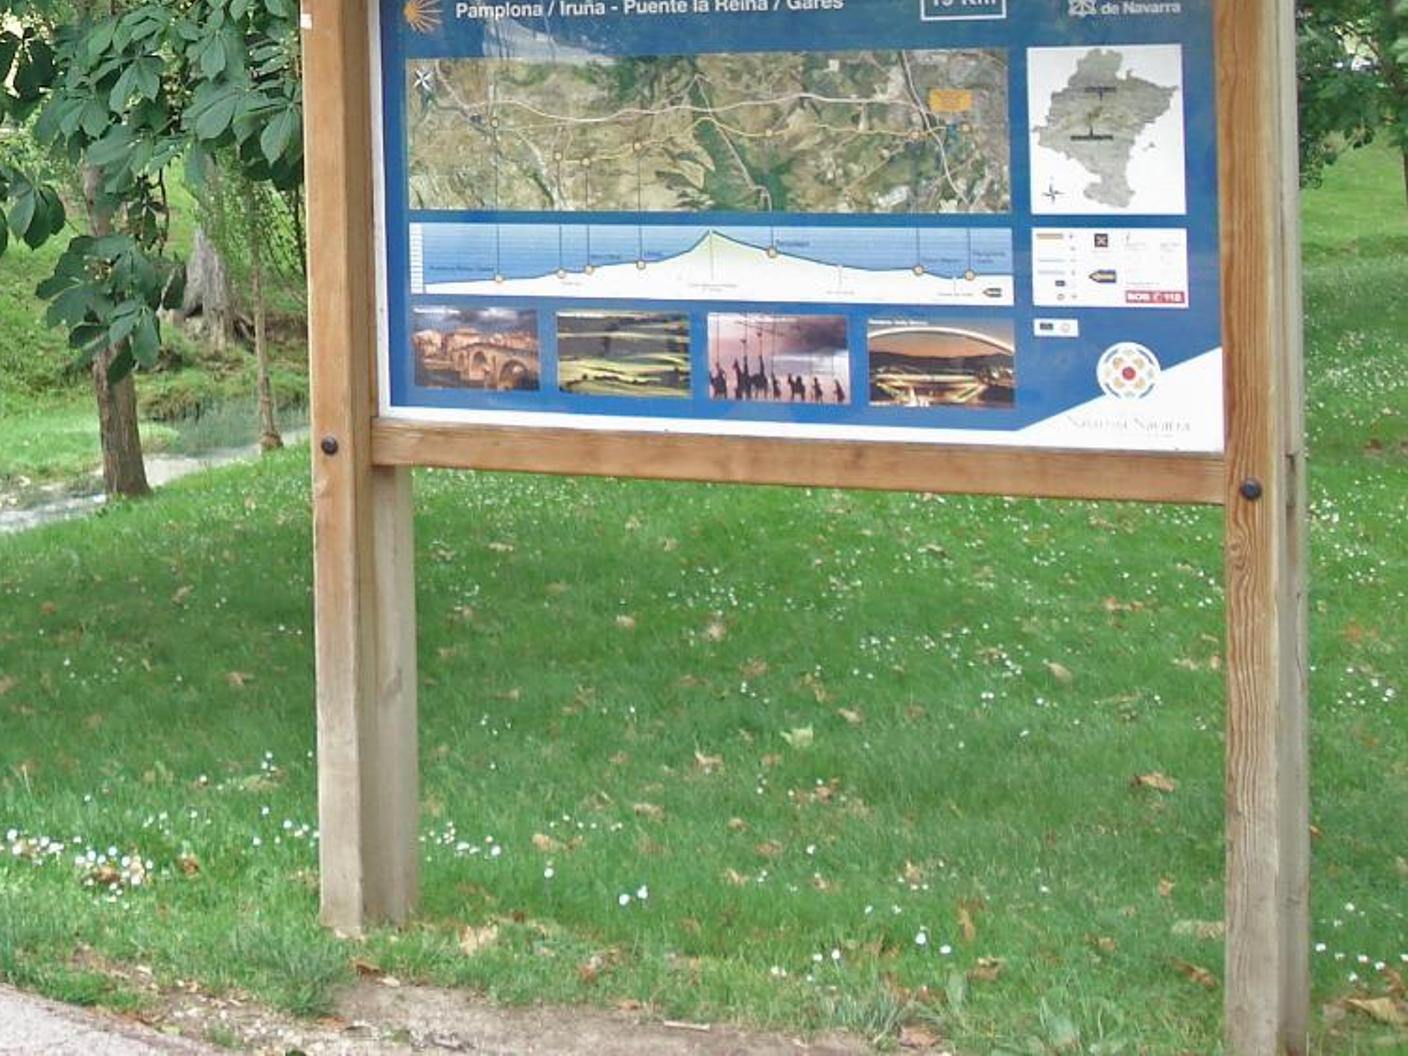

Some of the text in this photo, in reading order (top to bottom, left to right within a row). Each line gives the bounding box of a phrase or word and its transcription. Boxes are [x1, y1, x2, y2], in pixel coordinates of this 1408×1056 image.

[455, 1, 543, 20] Pamplona
[548, 0, 556, 17] /
[1101, 1, 1182, 15] de Navarra
